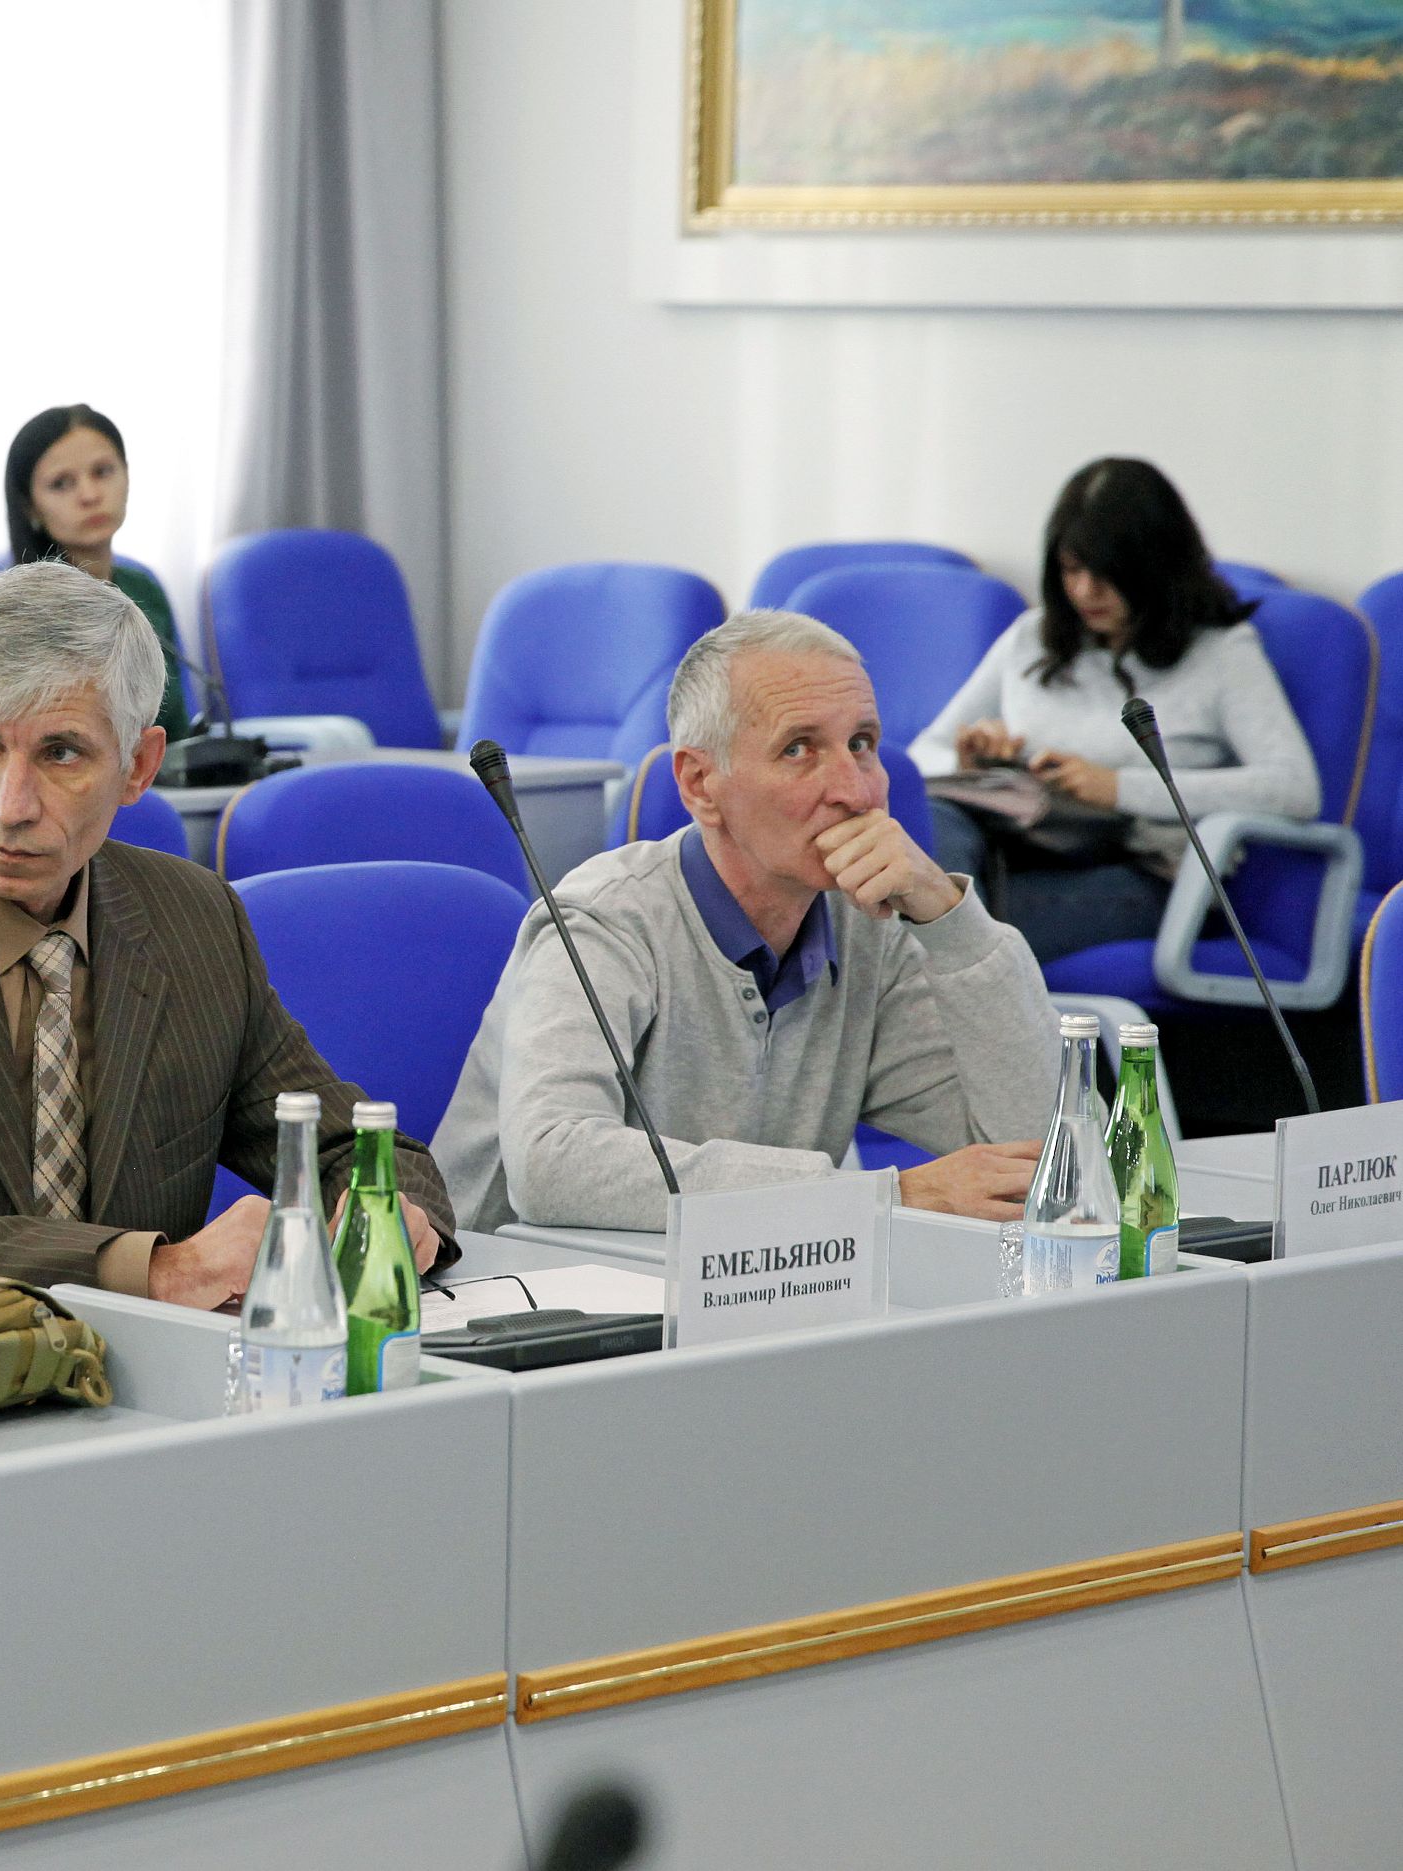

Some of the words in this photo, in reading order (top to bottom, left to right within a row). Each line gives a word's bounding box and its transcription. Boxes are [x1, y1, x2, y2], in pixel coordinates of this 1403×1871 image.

[1317, 1154, 1398, 1189] ПАРЛЮК
[1310, 1200, 1335, 1216] Олег
[1339, 1190, 1403, 1212] Николаевич
[700, 1236, 857, 1281] ЕМЕЛЬЯНОВ
[702, 1286, 777, 1309] Владимир
[780, 1277, 852, 1300] Иванович
